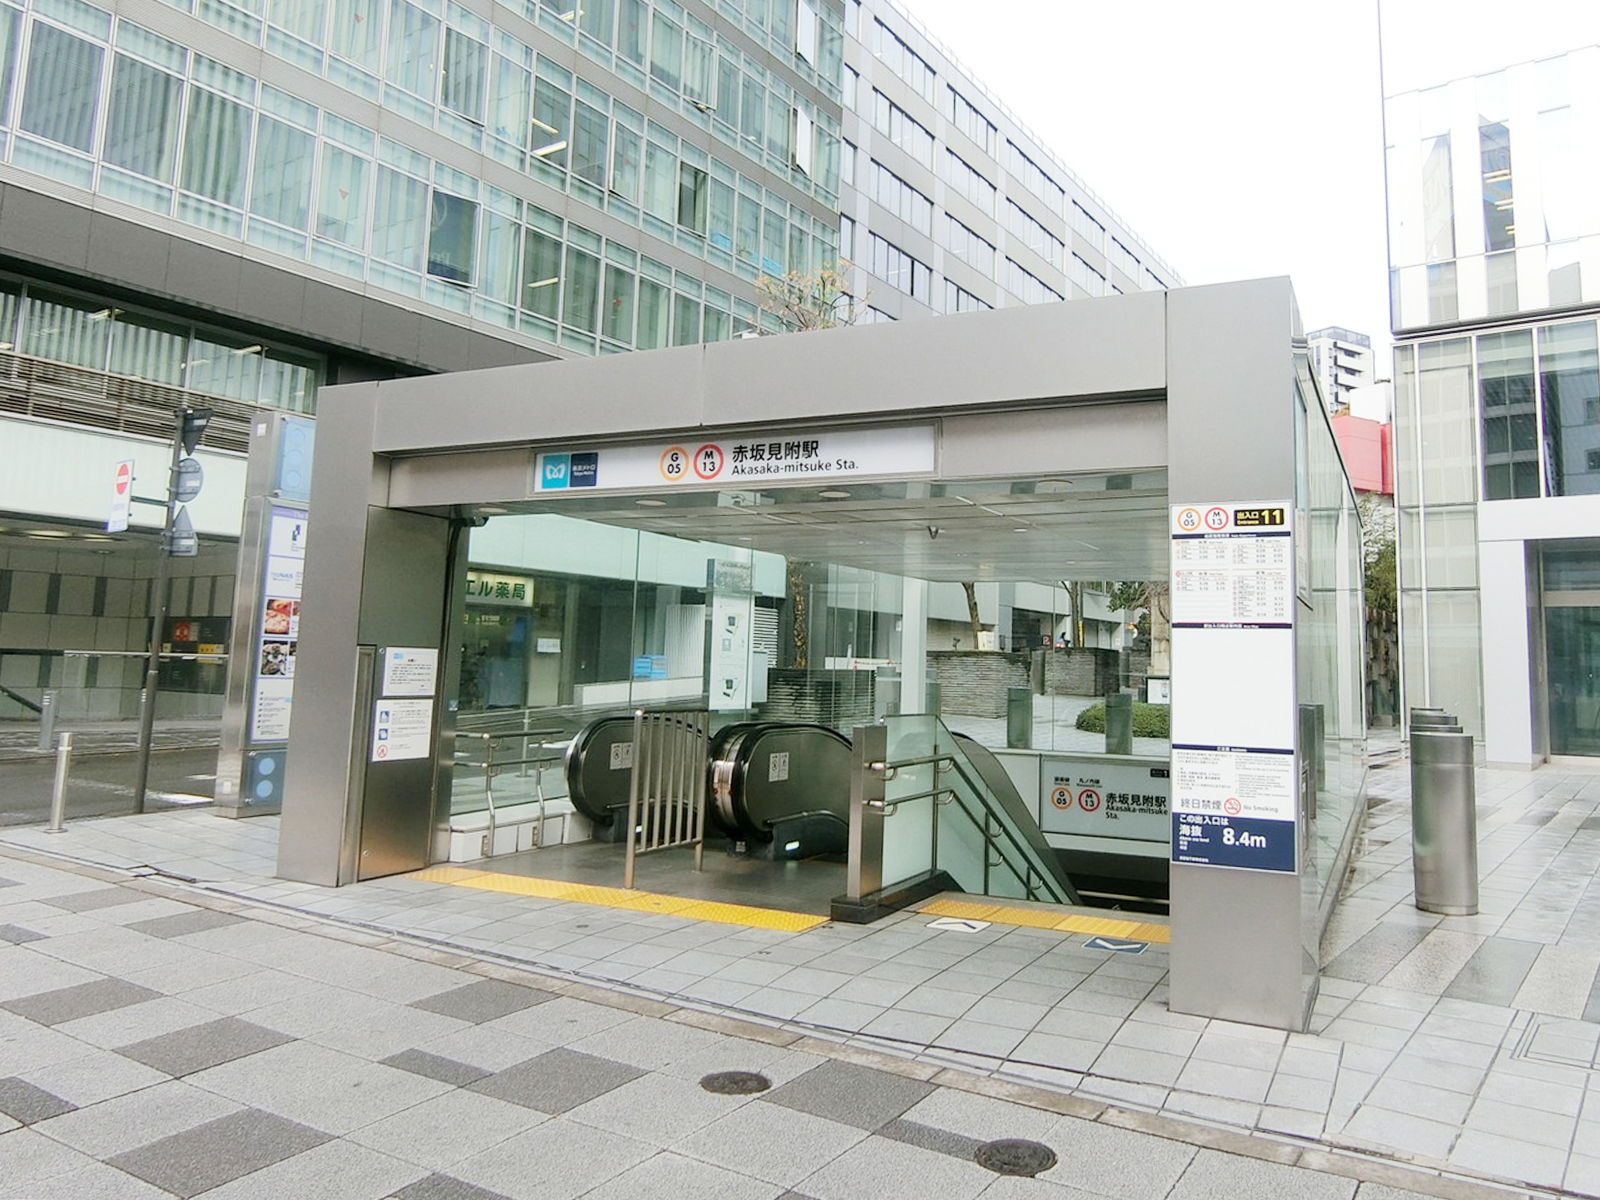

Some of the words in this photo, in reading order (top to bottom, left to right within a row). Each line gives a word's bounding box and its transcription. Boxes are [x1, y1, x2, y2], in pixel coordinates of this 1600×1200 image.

[670, 452, 679, 462] G
[704, 450, 714, 460] M
[732, 440, 819, 463] 赤坂見附駅
[667, 463, 681, 474] 05
[702, 461, 716, 472] 13
[731, 460, 832, 475] Akasaka-mitsuke
[836, 459, 859, 470] Sta.
[1236, 511, 1259, 519] 出入口
[1261, 509, 1282, 525] 11
[1183, 518, 1195, 527] 05
[1212, 518, 1223, 526] 13
[465, 579, 526, 601] エル薬局
[1084, 799, 1095, 807] 13
[1105, 793, 1167, 808] 赤坂見附駅
[1181, 798, 1222, 810] 終日禁煙
[1253, 804, 1278, 813] Smoking
[1105, 812, 1120, 820] Sta.
[1179, 814, 1229, 826] この出入口は
[1179, 824, 1203, 837] 海抜
[1222, 827, 1267, 848] 8.4m
